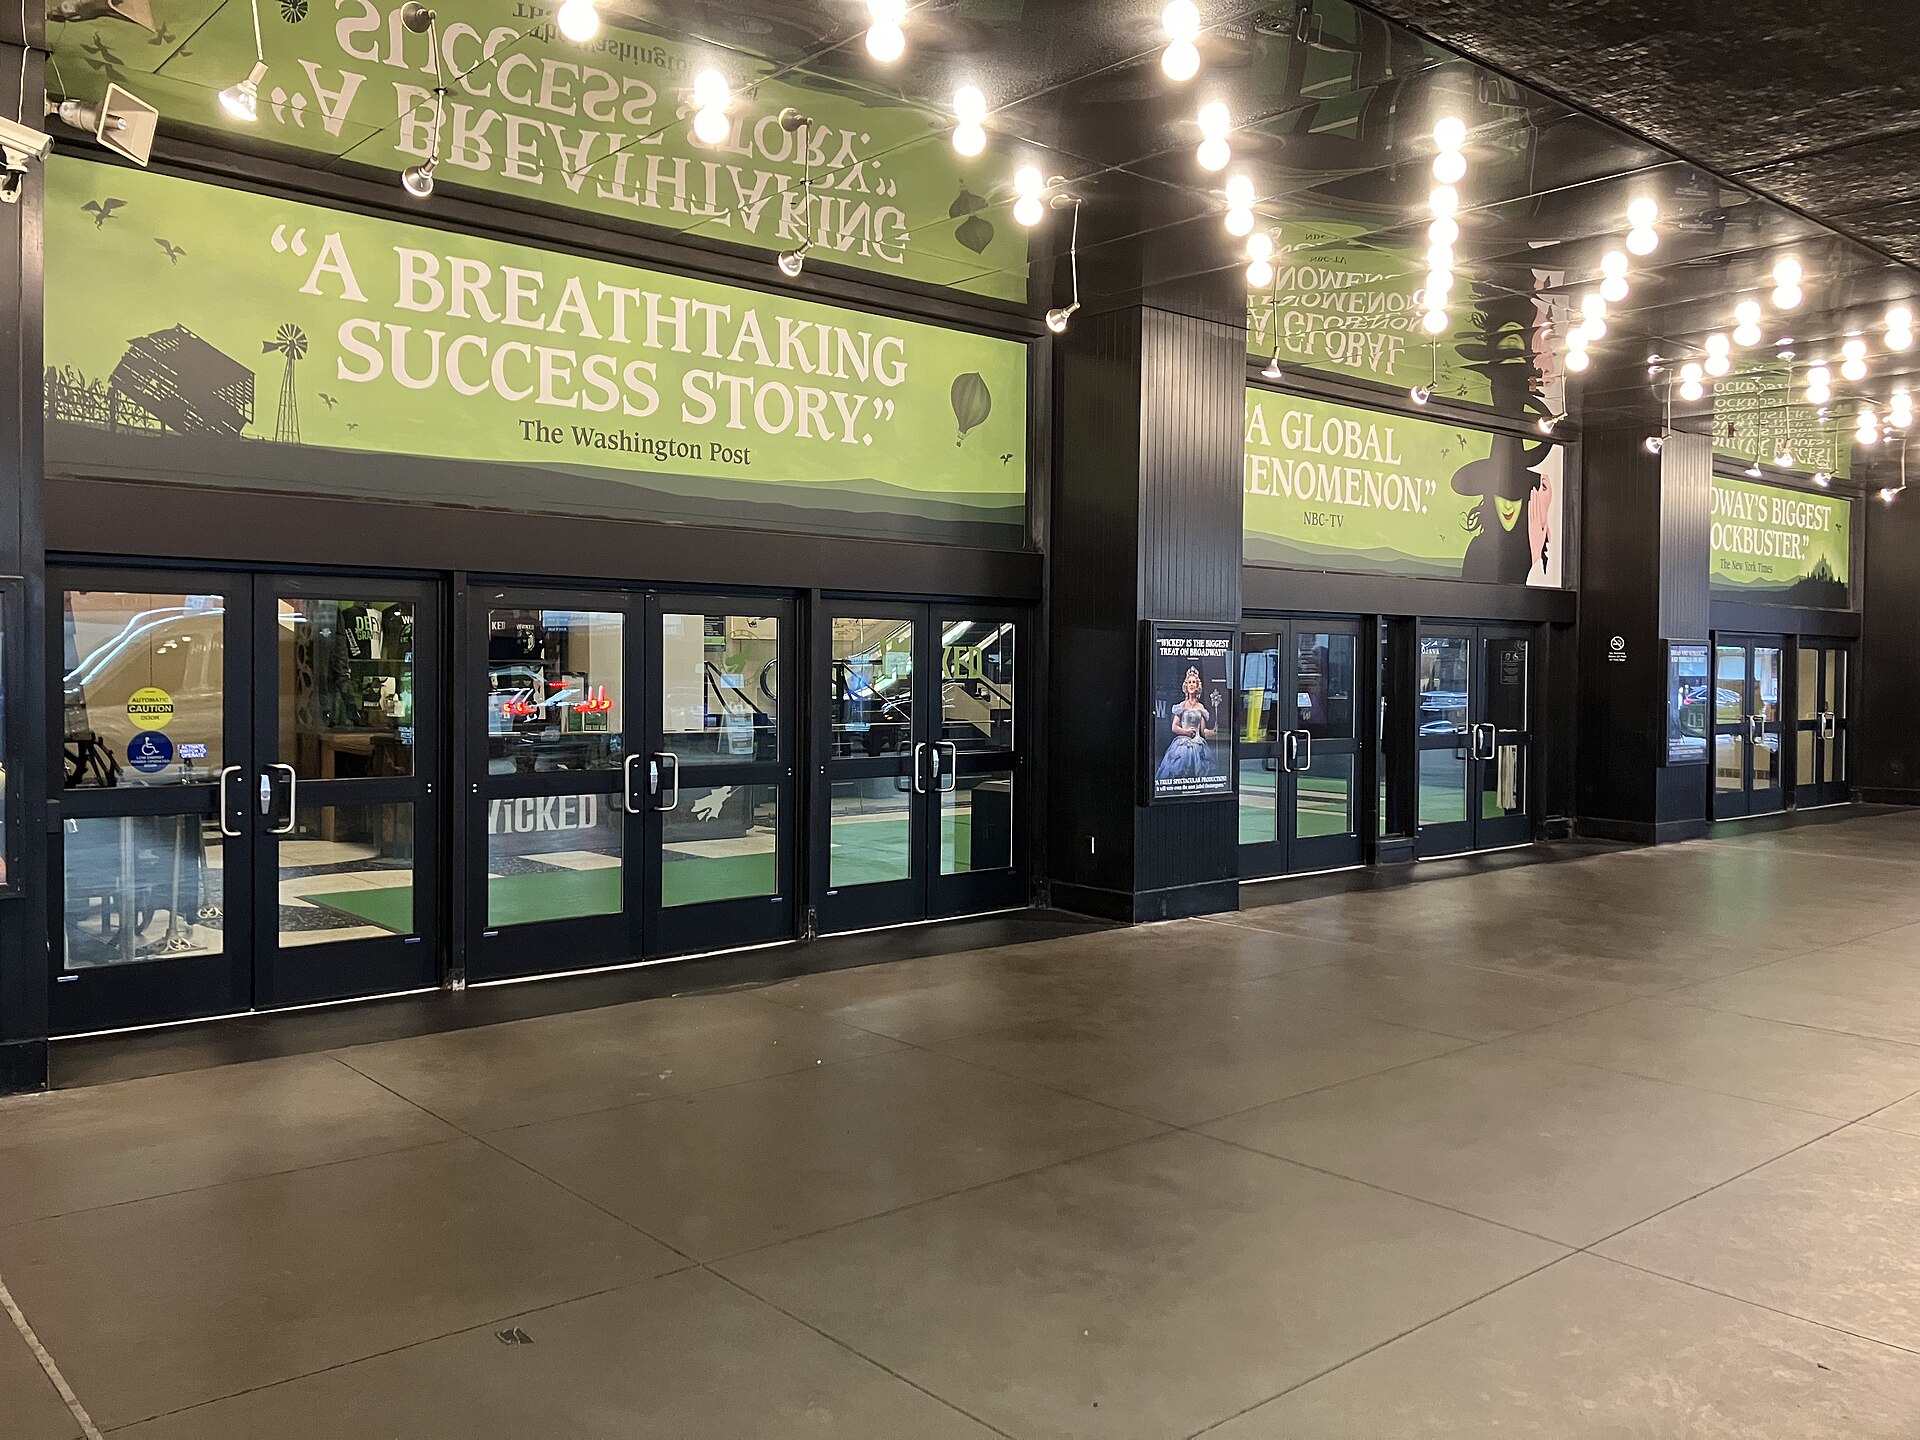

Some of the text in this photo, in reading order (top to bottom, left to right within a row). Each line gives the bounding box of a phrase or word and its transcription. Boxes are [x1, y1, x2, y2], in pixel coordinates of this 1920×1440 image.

[270, 223, 909, 388] “A BREATHTAKING
[336, 317, 896, 448] SUCCESS STORY.”
[518, 418, 751, 467] The Washington Post
[1244, 401, 1403, 466] A GLOBAL
[1303, 510, 1345, 528] NBC-TV
[1771, 497, 1833, 532] BIGGEST
[1720, 558, 1774, 574] The New York Times
[1160, 648, 1180, 656] TREAT
[1180, 648, 1189, 656] ON
[1193, 639, 1205, 648] THE
[1206, 639, 1230, 648] BIGGEST
[128, 705, 172, 713] CAUTION
